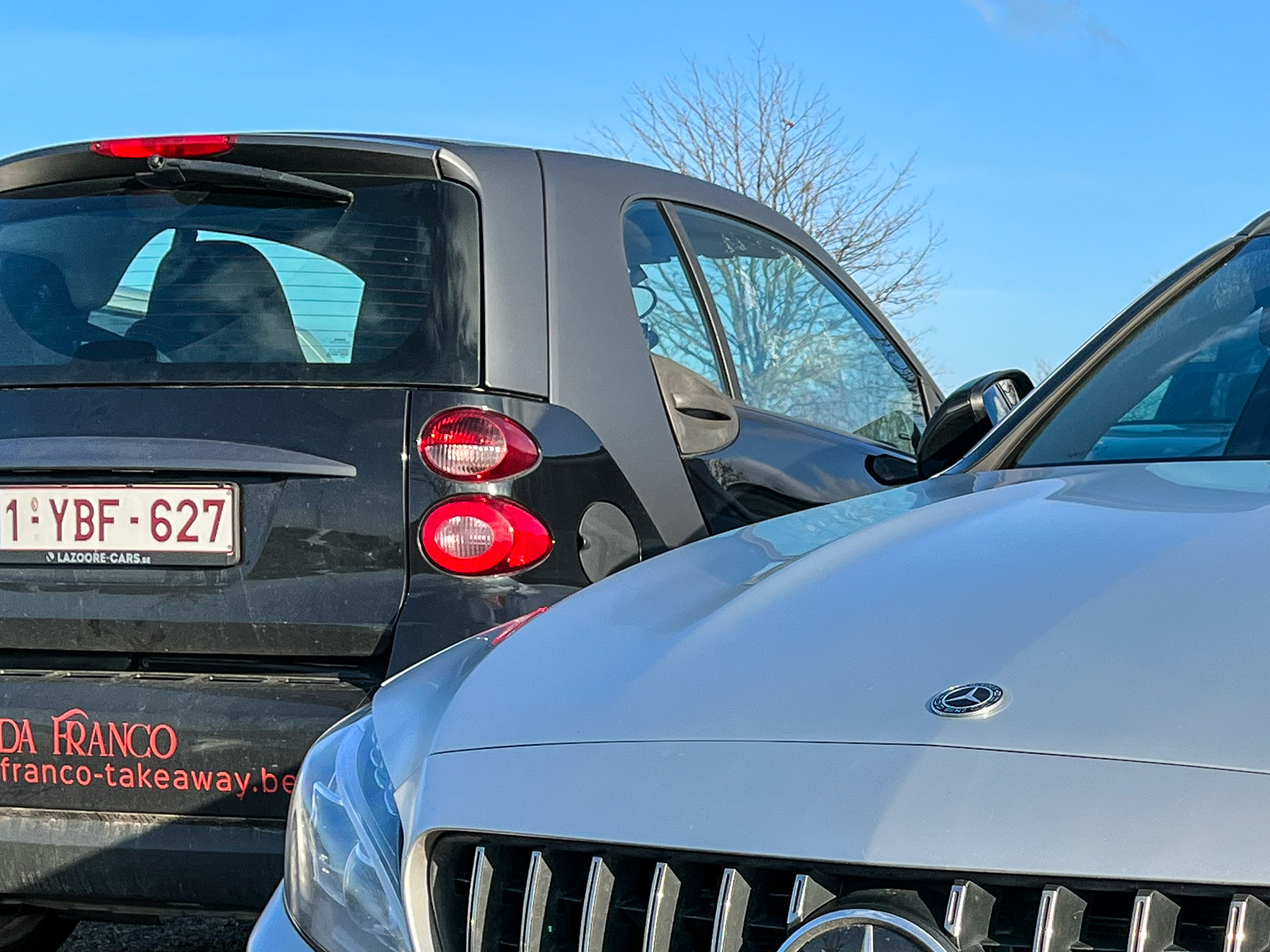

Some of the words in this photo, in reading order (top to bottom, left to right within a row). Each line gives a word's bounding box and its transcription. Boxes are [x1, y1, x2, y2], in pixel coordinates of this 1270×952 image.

[0, 717, 38, 753] DA
[51, 707, 178, 759] FRANCO
[0, 756, 296, 800] franco-takeaway.be
